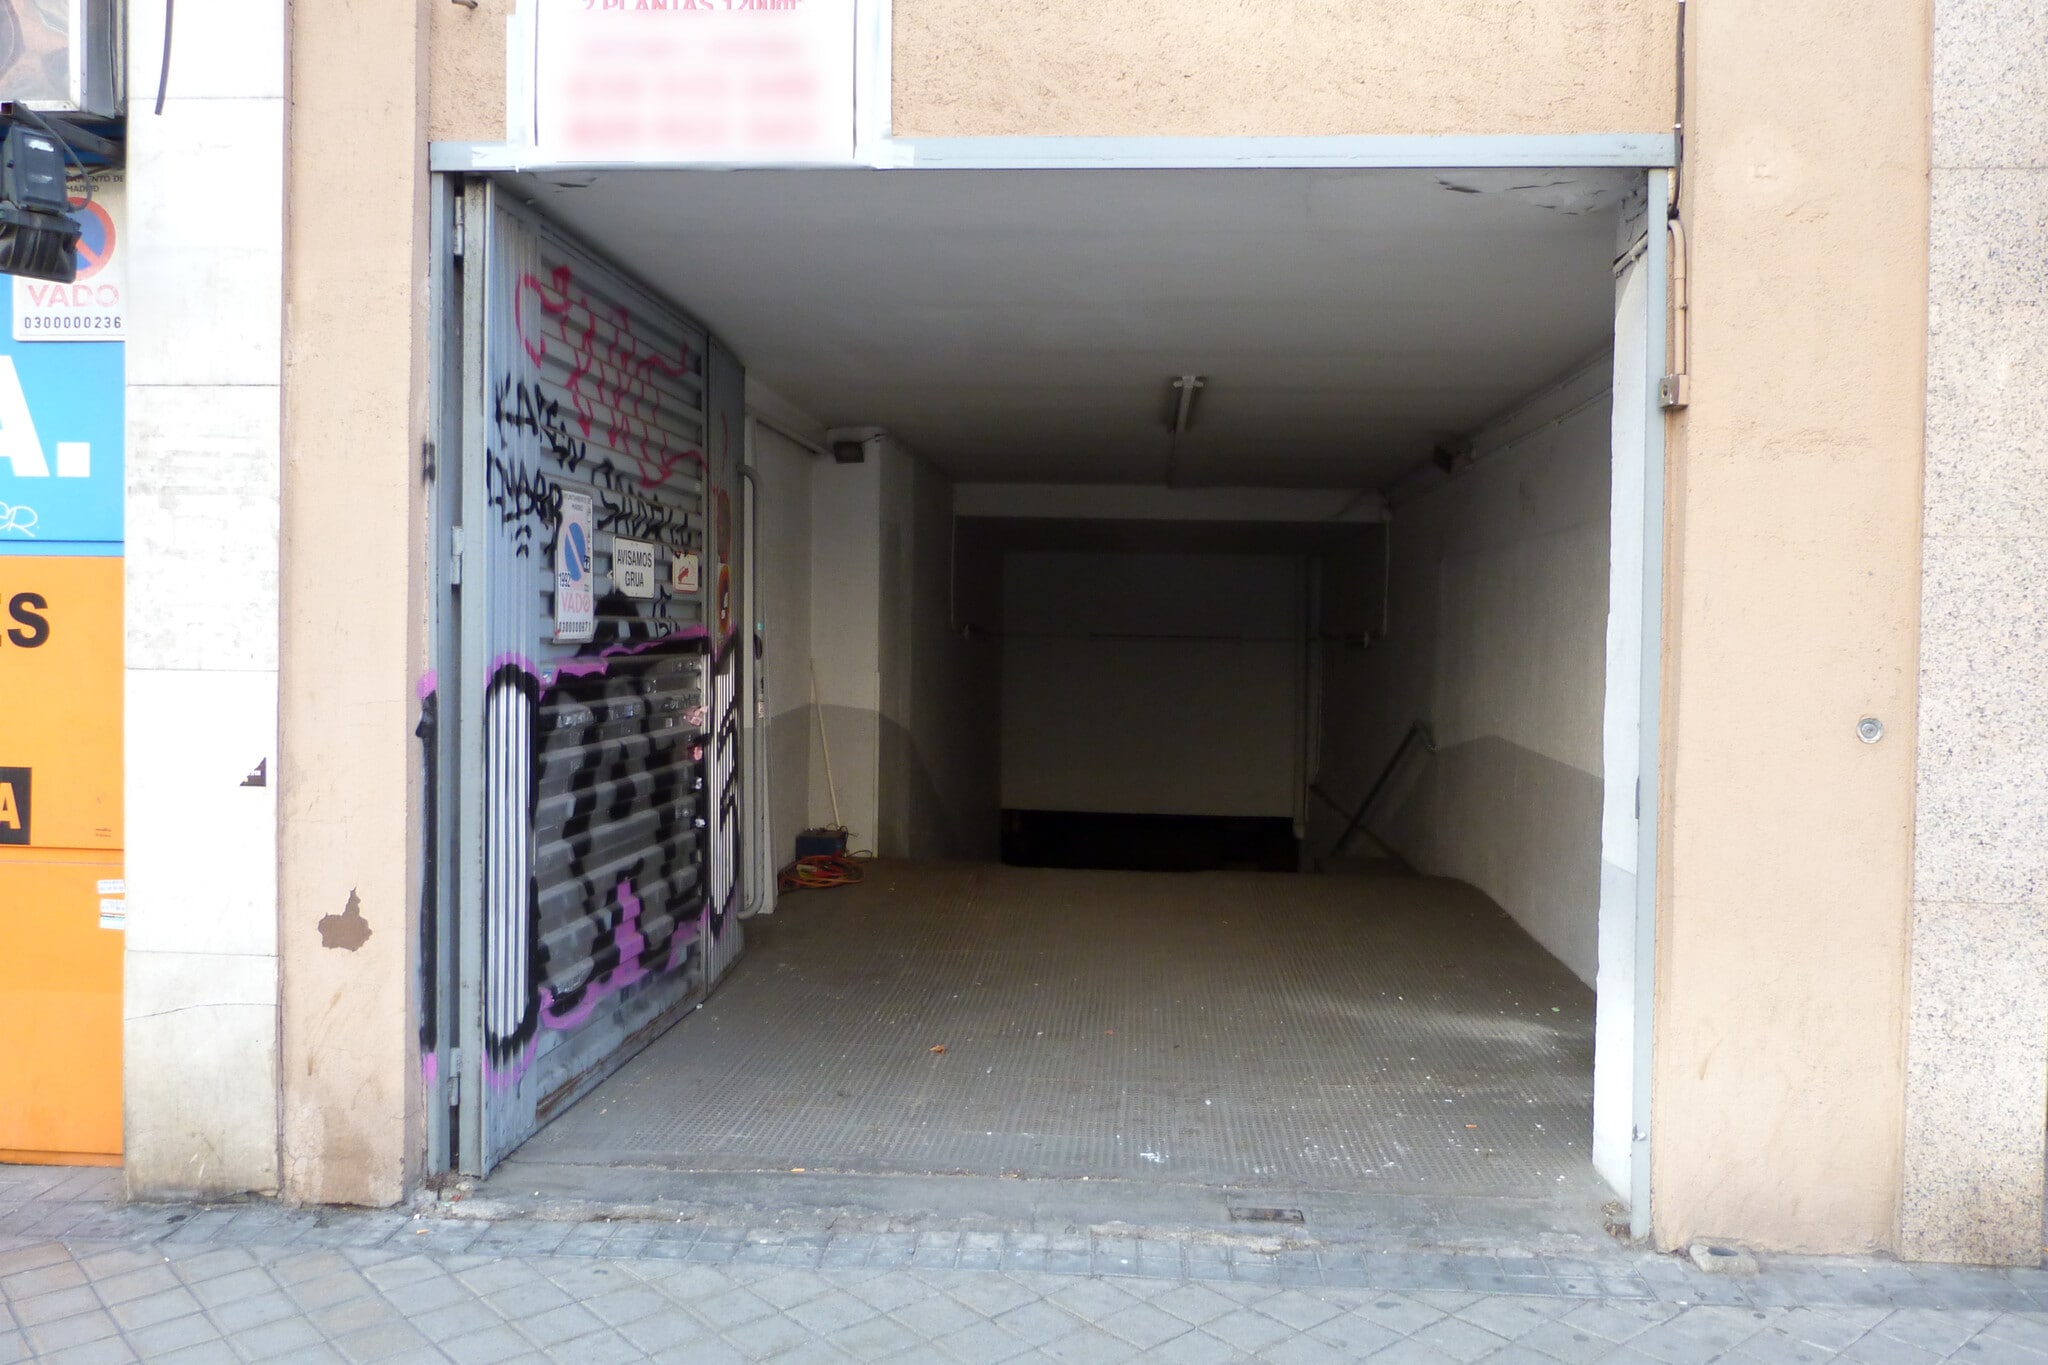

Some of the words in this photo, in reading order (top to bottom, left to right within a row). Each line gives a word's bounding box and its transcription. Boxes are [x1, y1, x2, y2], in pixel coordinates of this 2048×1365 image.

[27, 284, 120, 308] VADO
[24, 316, 122, 329] 0300000236
[617, 549, 653, 568] AVISAMOS
[625, 571, 645, 587] GRUA
[561, 592, 591, 613] VADO
